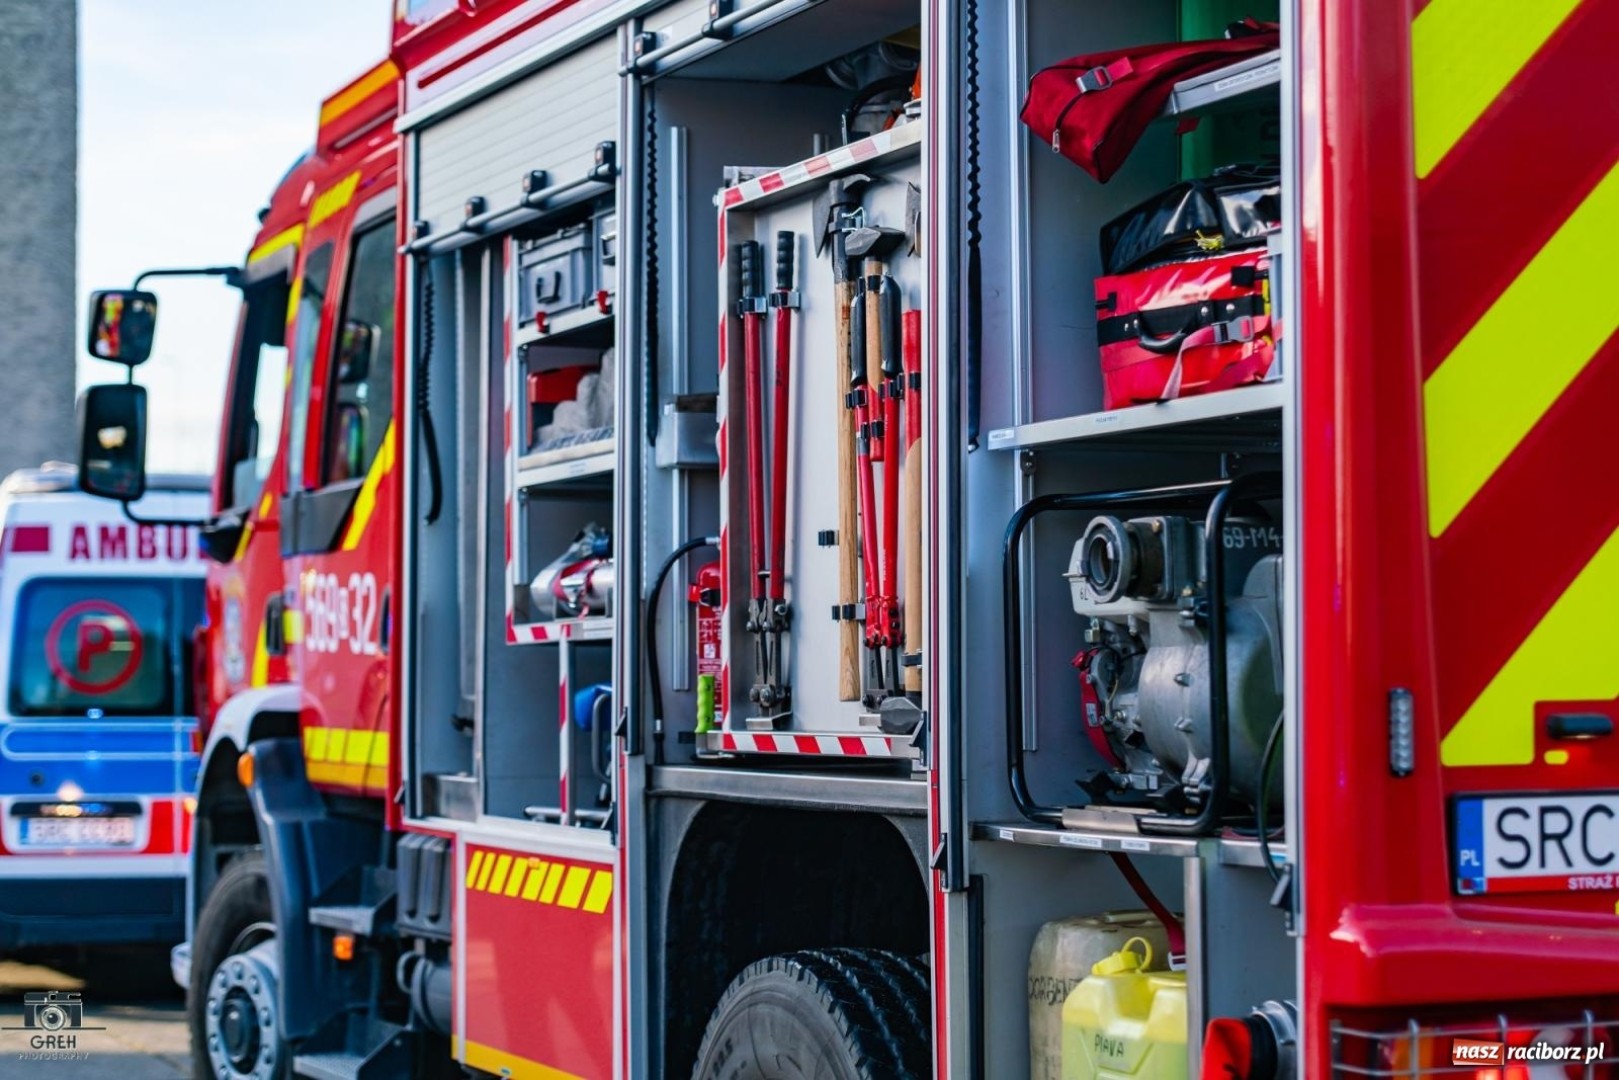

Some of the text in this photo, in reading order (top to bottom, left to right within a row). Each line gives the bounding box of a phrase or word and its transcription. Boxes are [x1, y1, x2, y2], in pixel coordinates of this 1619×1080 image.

[71, 525, 209, 559] AMBU
[1496, 804, 1615, 870] SRC
[1460, 850, 1480, 867] PL
[1567, 874, 1613, 890] STRAŻ
